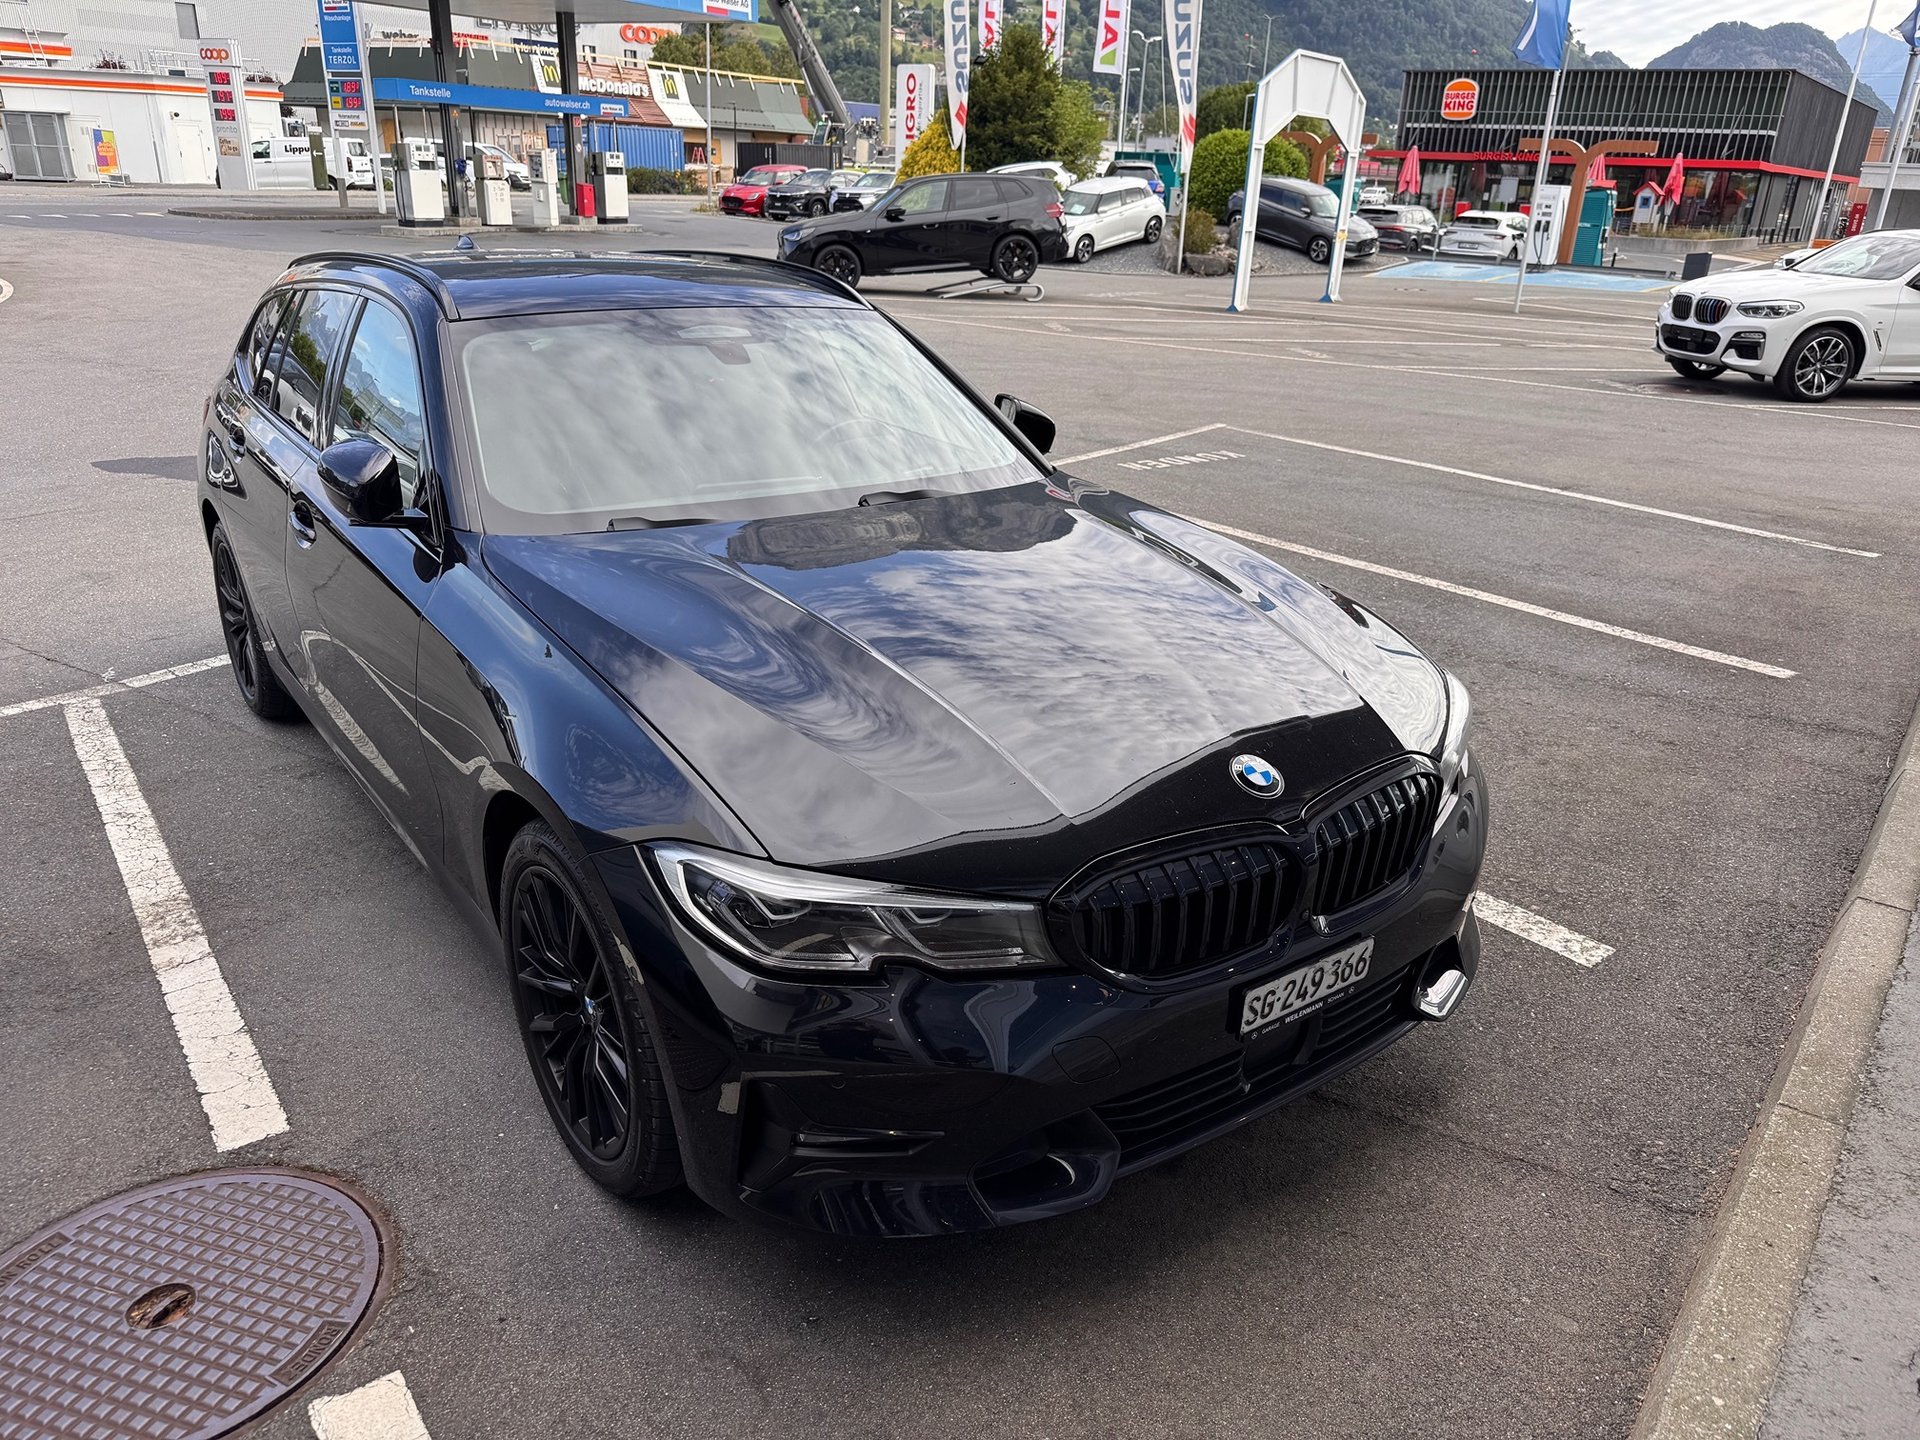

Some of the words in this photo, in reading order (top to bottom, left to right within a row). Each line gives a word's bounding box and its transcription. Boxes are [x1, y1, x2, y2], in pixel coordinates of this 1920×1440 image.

[200, 48, 229, 63] coop
[328, 56, 357, 65] TERZOL
[409, 85, 451, 99] Tankstelle
[578, 76, 649, 97] McDonald's
[1445, 92, 1476, 100] BURGER
[544, 98, 591, 110] autowalser.ch
[905, 72, 917, 140] IGRO
[1443, 100, 1475, 111] KING
[1473, 152, 1513, 161] BURGER
[1515, 153, 1541, 162] KING
[1117, 450, 1246, 471] KUNDEN
[1284, 1001, 1324, 1024] WEILENMANN
